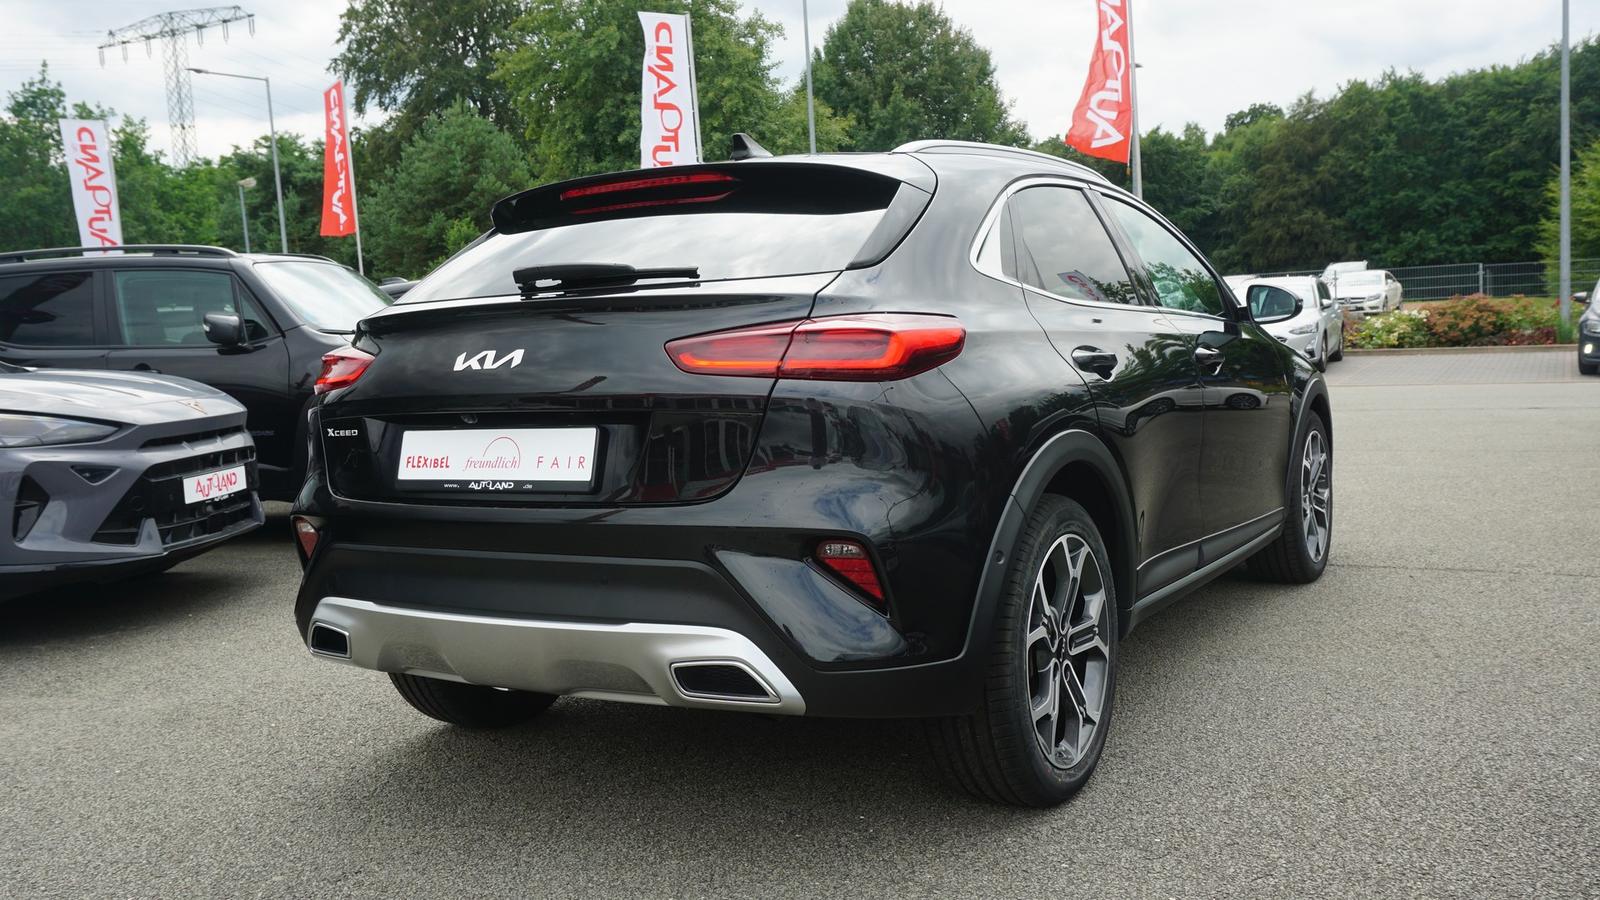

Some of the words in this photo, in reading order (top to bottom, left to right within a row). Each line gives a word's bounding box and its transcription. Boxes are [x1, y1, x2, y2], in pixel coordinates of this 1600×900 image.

[453, 348, 525, 372] KIA
[327, 428, 358, 437] XCEED
[405, 455, 450, 469] FLEXIBEL
[462, 456, 518, 472] freundlich
